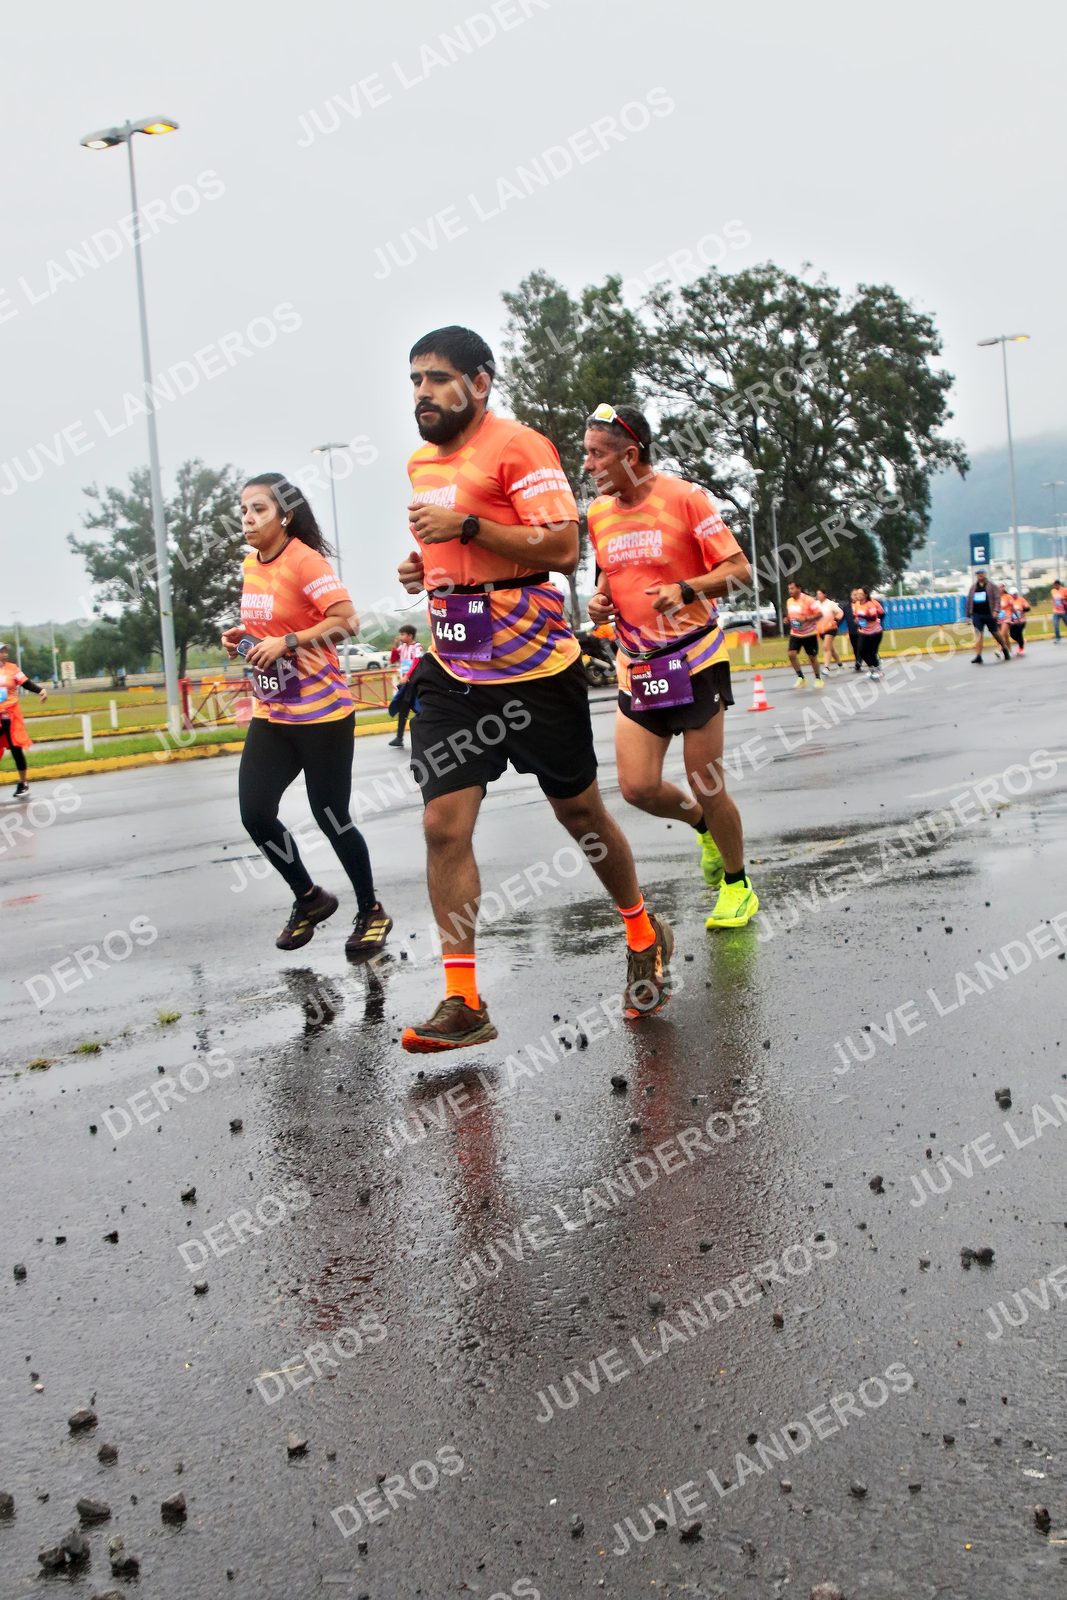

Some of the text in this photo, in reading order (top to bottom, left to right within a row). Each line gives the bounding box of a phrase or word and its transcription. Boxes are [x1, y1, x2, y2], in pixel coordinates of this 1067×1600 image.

[608, 530, 662, 553] CARRERA
[608, 548, 649, 563] OMNILIFE
[974, 547, 985, 561] E
[468, 601, 484, 613] 15K
[436, 621, 466, 641] 448
[258, 675, 278, 690] 136
[642, 679, 669, 696] 269
